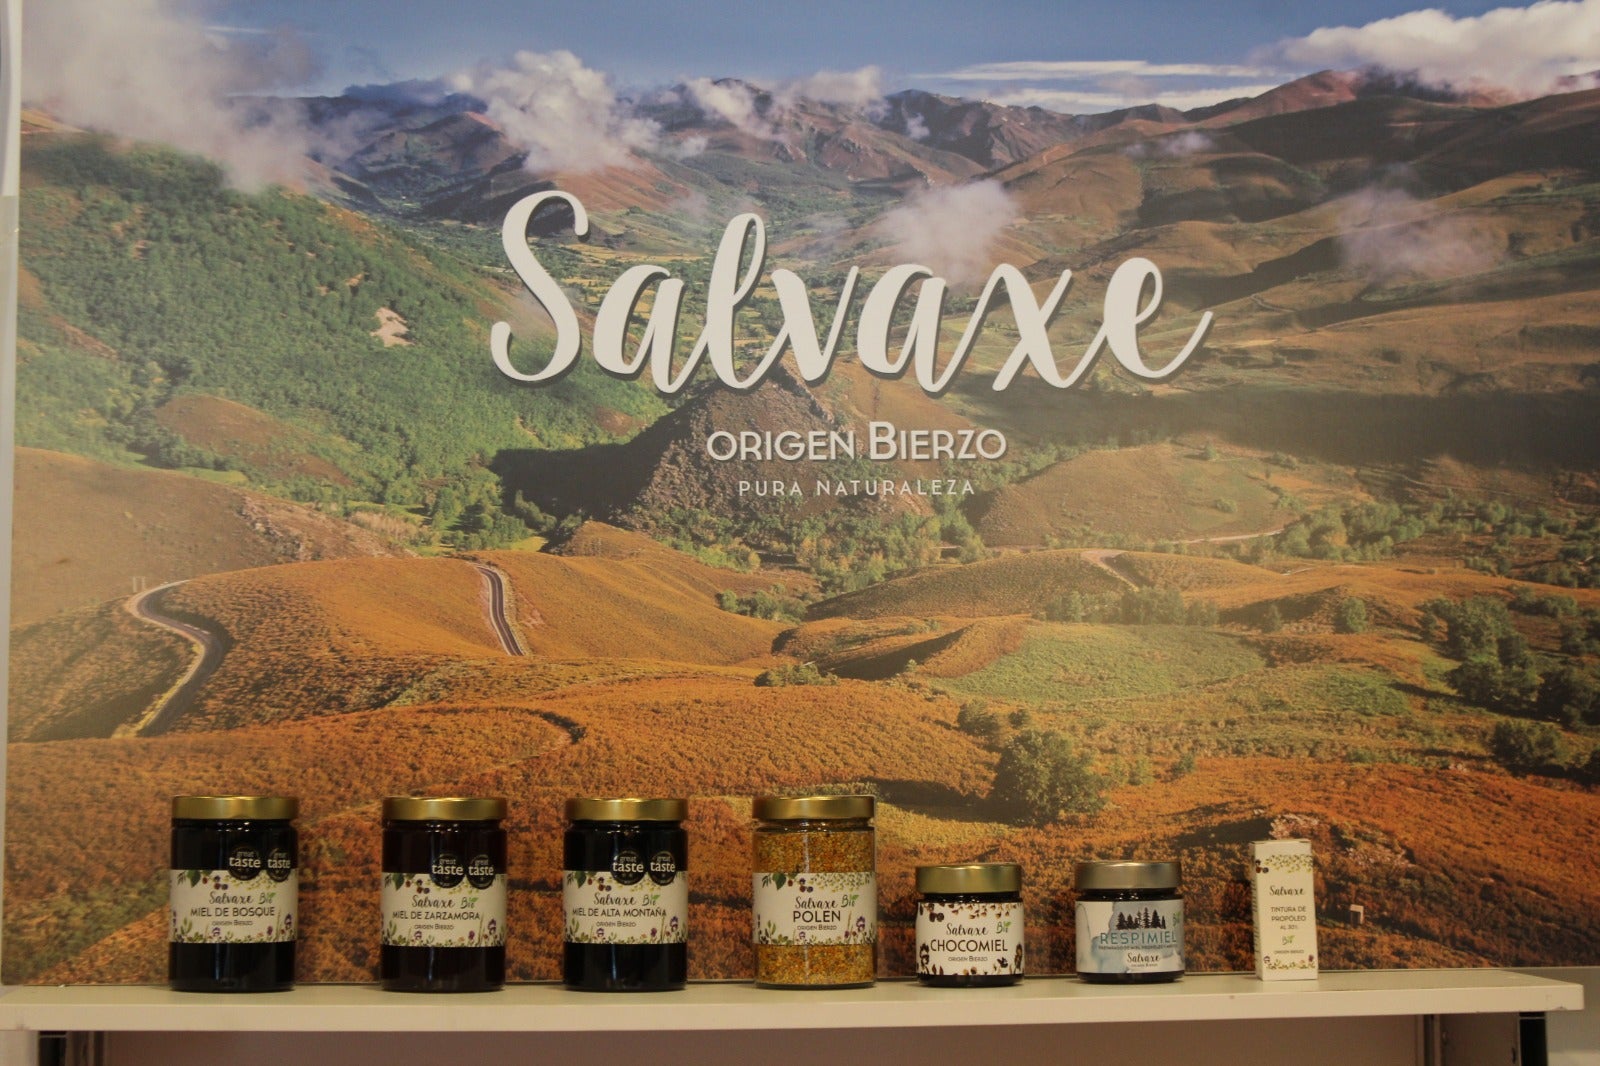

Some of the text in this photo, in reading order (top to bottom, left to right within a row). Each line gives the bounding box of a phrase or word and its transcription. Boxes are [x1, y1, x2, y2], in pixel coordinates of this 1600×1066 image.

[490, 190, 1213, 394] Salvaxe
[706, 421, 1007, 462] ORIGEN BIERZO
[738, 480, 976, 497] PURA NATURALEZA
[229, 856, 261, 868] taste
[267, 858, 291, 869] taste
[613, 862, 644, 873] taste
[650, 862, 675, 873] taste
[432, 865, 464, 876] taste
[468, 865, 494, 876] taste
[1269, 885, 1305, 896] Salvaxe
[209, 891, 254, 904] Salvaxe
[412, 895, 455, 908] Salvaxe
[594, 893, 636, 905] Salvaxe
[795, 896, 838, 909] Salvaxe
[190, 907, 275, 917] MIEL DE BOSQUE
[393, 911, 408, 919] MIEL
[424, 911, 480, 920] ZARZAMORA
[573, 908, 667, 917] MIEL DE ALTA MONTAÑA
[793, 911, 841, 922] POLEN
[946, 923, 988, 936] Salvaxe
[1100, 931, 1176, 944] RESPIMIEL
[930, 940, 1008, 952] CHOCOMIEL
[1127, 953, 1160, 963] Salvaxe
